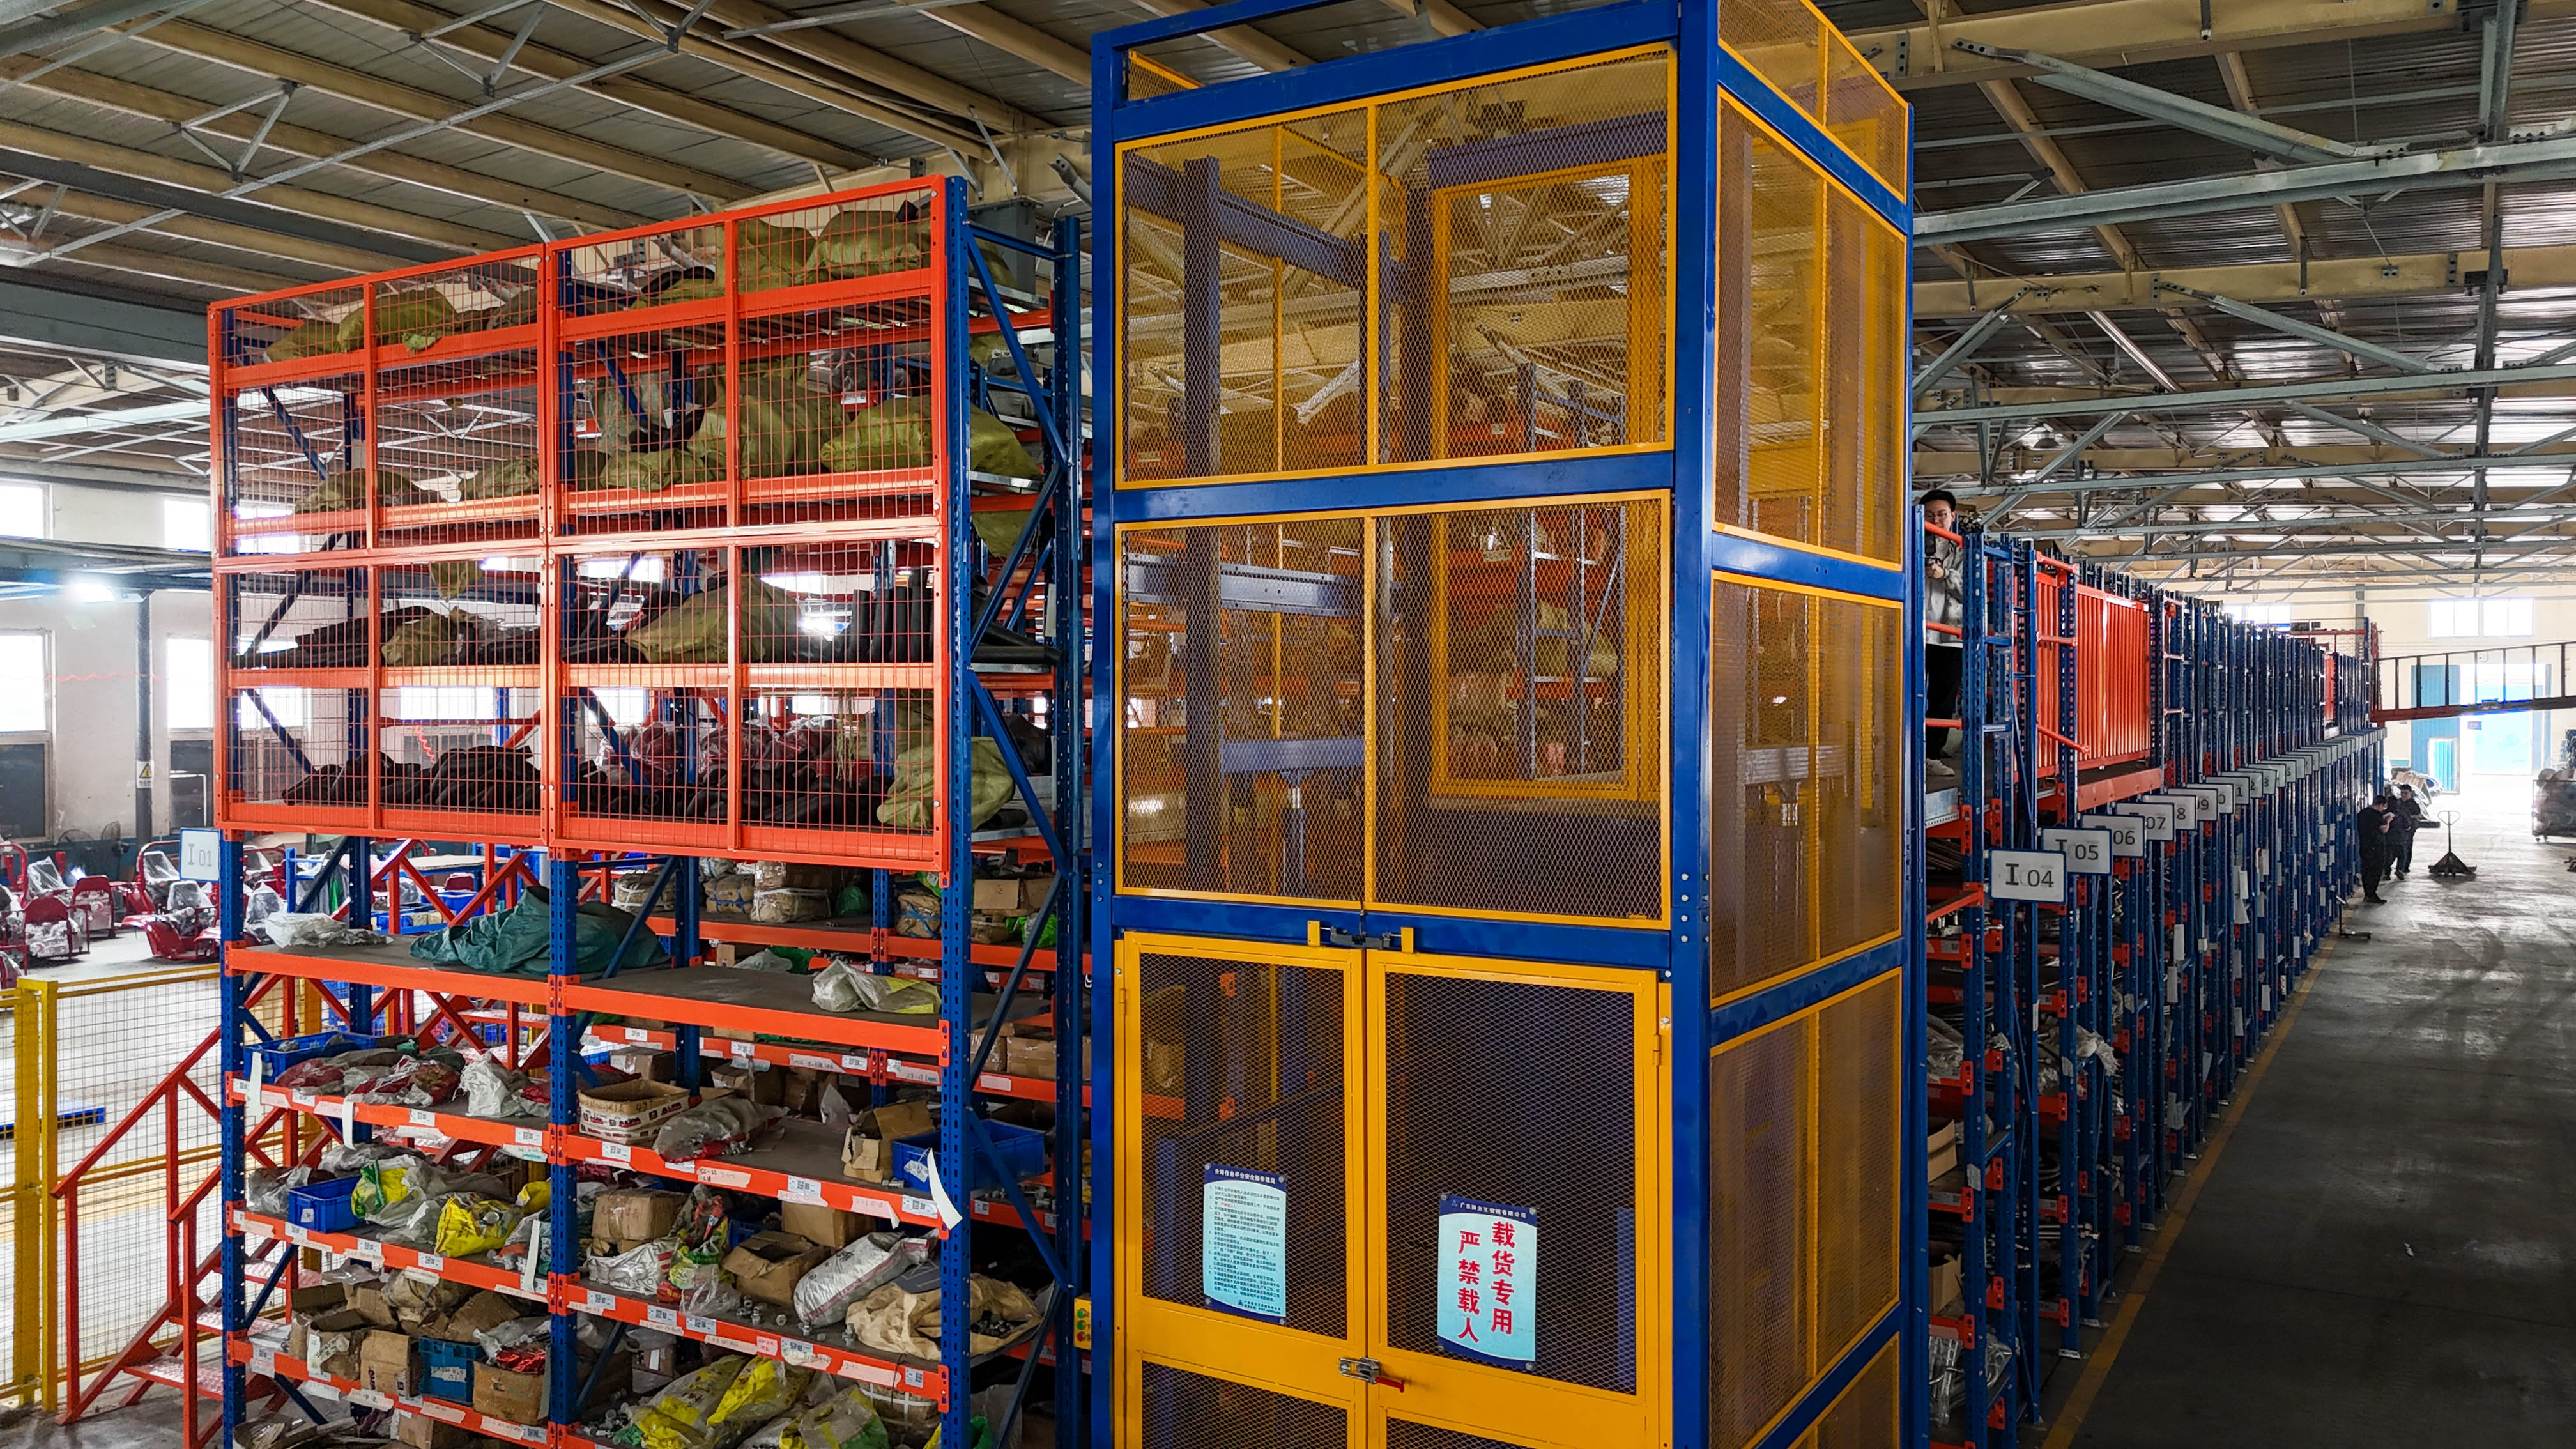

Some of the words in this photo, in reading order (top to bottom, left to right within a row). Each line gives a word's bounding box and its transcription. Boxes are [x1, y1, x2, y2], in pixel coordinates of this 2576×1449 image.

[2177, 808, 2186, 820] 8
[2146, 816, 2166, 829] 07
[2113, 830, 2135, 845] 06
[2076, 844, 2099, 860] 05
[2027, 870, 2054, 888] 04
[1491, 1221, 1515, 1335] 载货专用
[1458, 1230, 1480, 1343] 严禁载人
